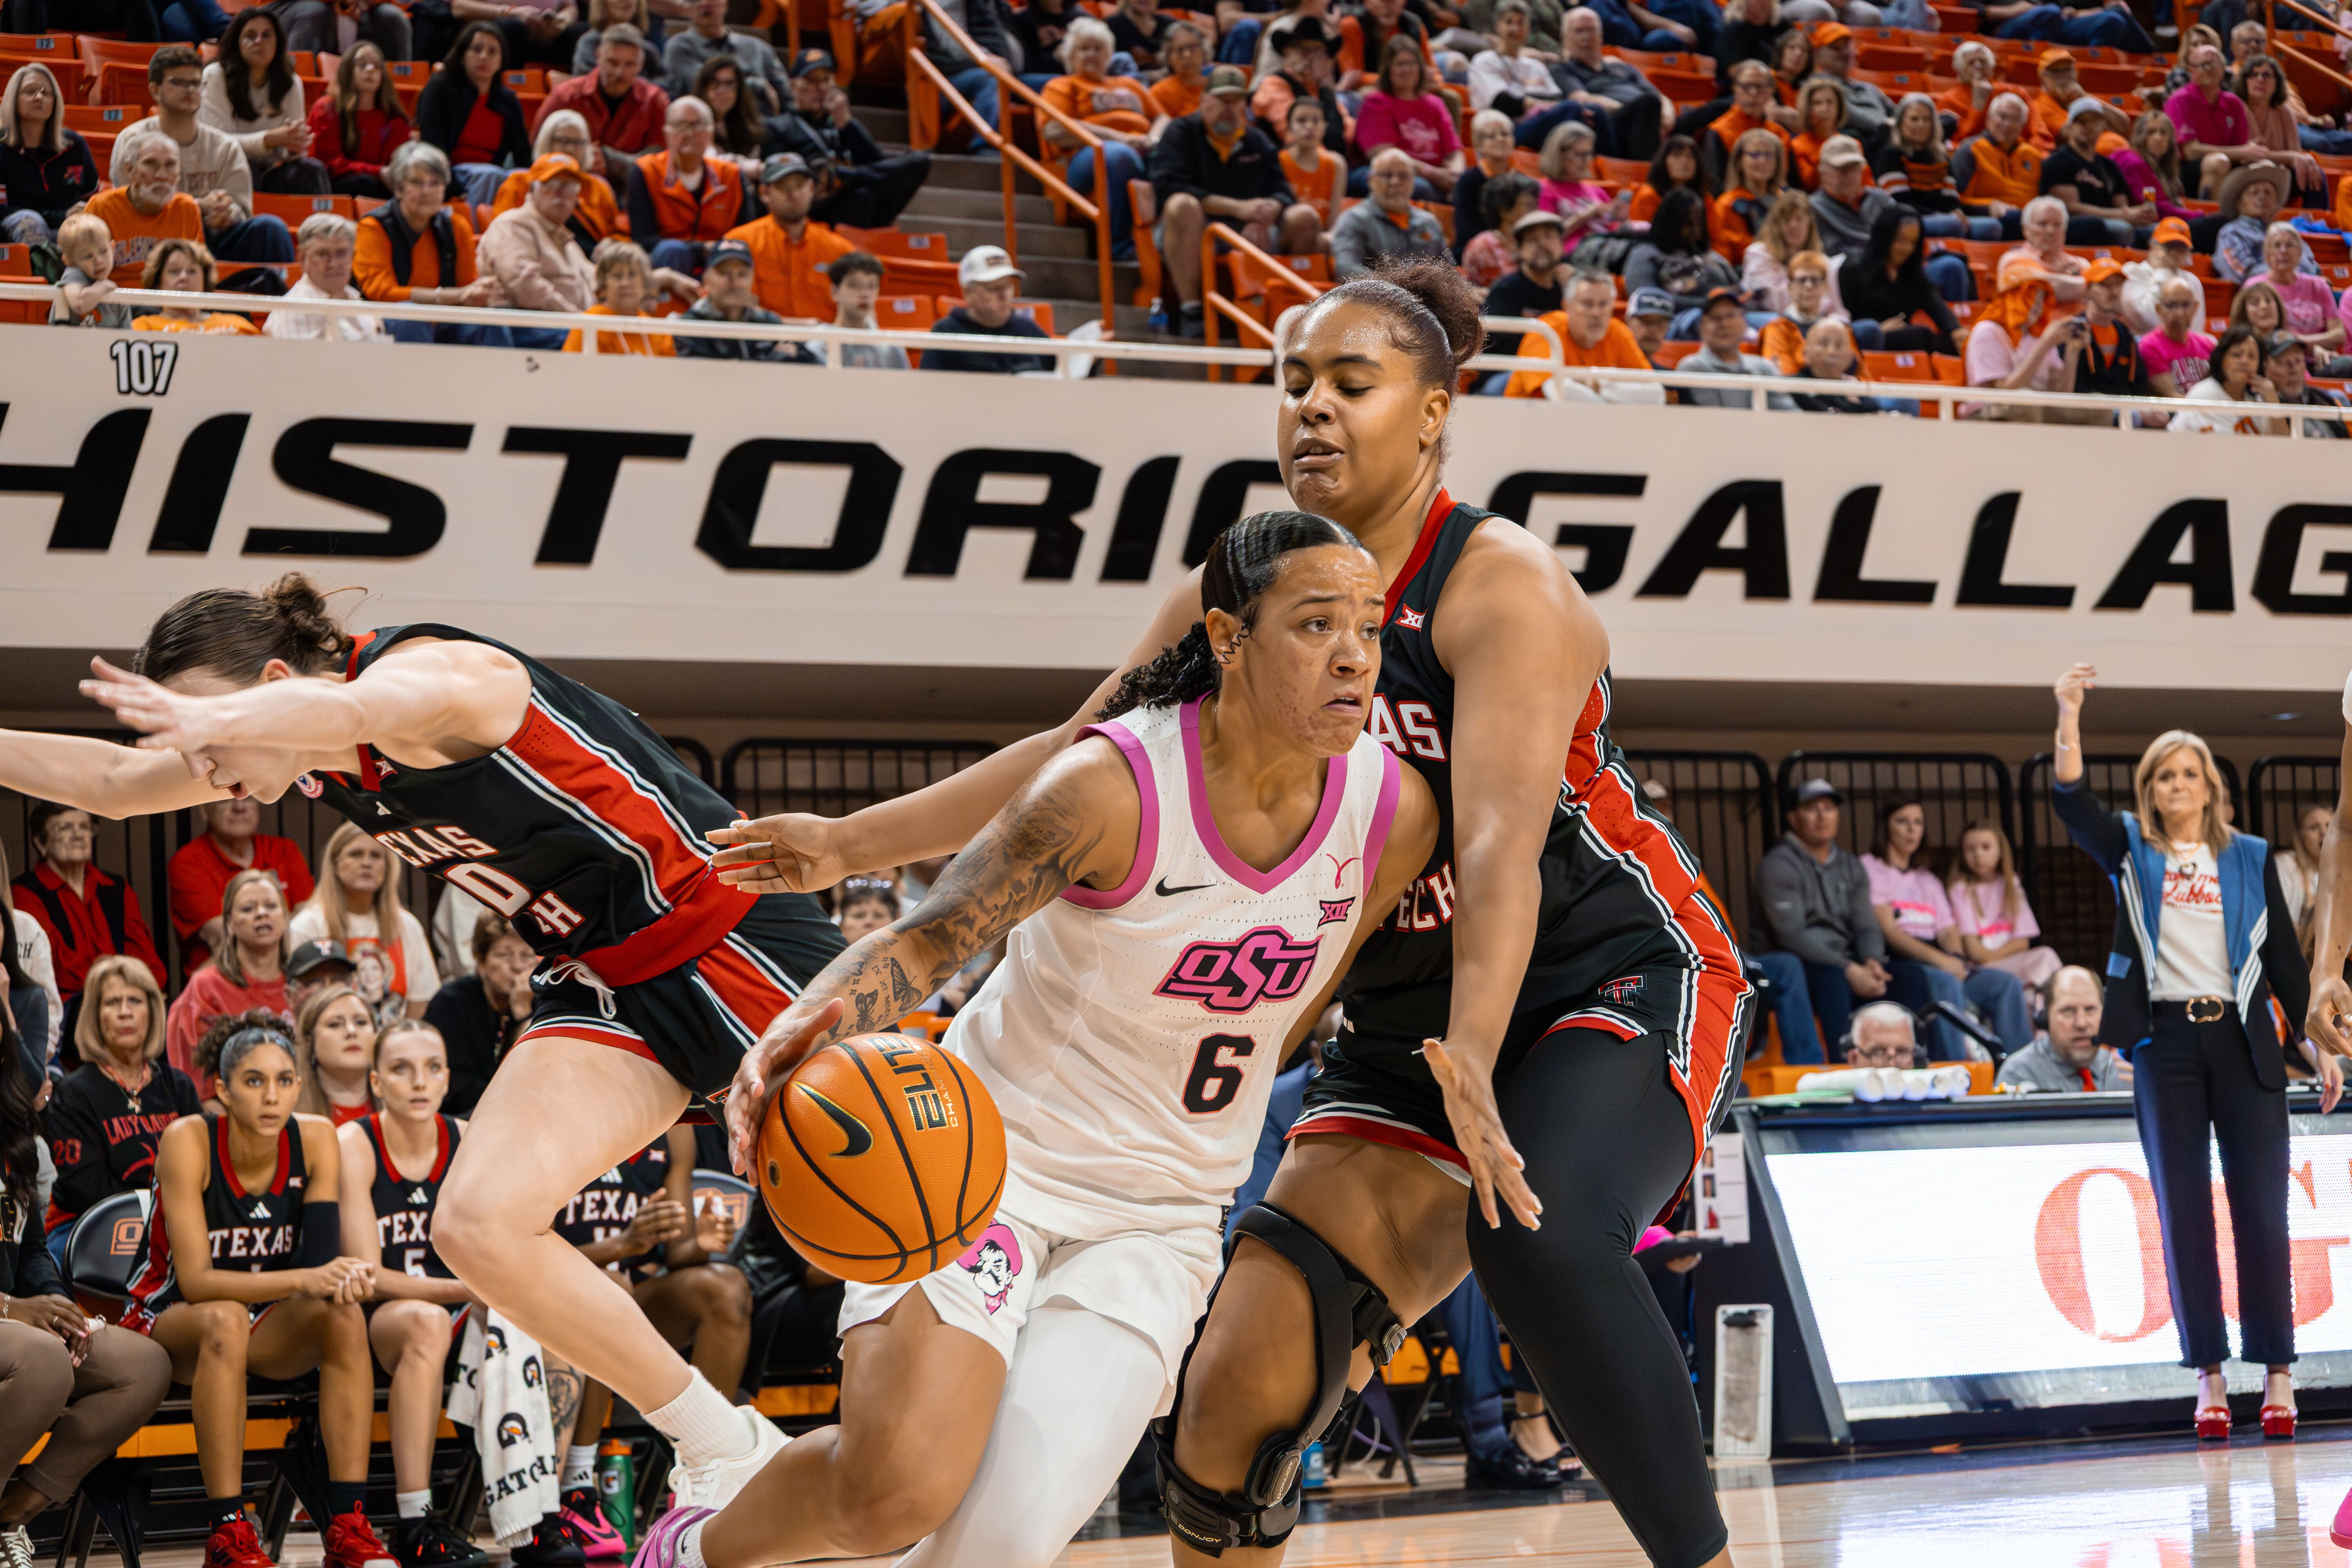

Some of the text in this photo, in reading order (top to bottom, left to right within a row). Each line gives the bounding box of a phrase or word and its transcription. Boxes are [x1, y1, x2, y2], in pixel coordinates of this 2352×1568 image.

[110, 339, 179, 396] 107
[373, 826, 499, 867] EXAS
[2163, 881, 2222, 904] Lubboc
[1319, 900, 1352, 924] XII
[1153, 925, 1324, 1014] OSU
[862, 1035, 949, 1131] ELITE
[1182, 1033, 1256, 1114] 6
[103, 1114, 140, 1146] LADY
[53, 1138, 82, 1165] 20
[565, 1190, 648, 1225] TEXA
[209, 1225, 294, 1259] TEXAS
[377, 1210, 431, 1248] TEX
[405, 1249, 427, 1278] 5
[1277, 1461, 1293, 1499] DONJOY
[1178, 1524, 1221, 1543] DONJOY
